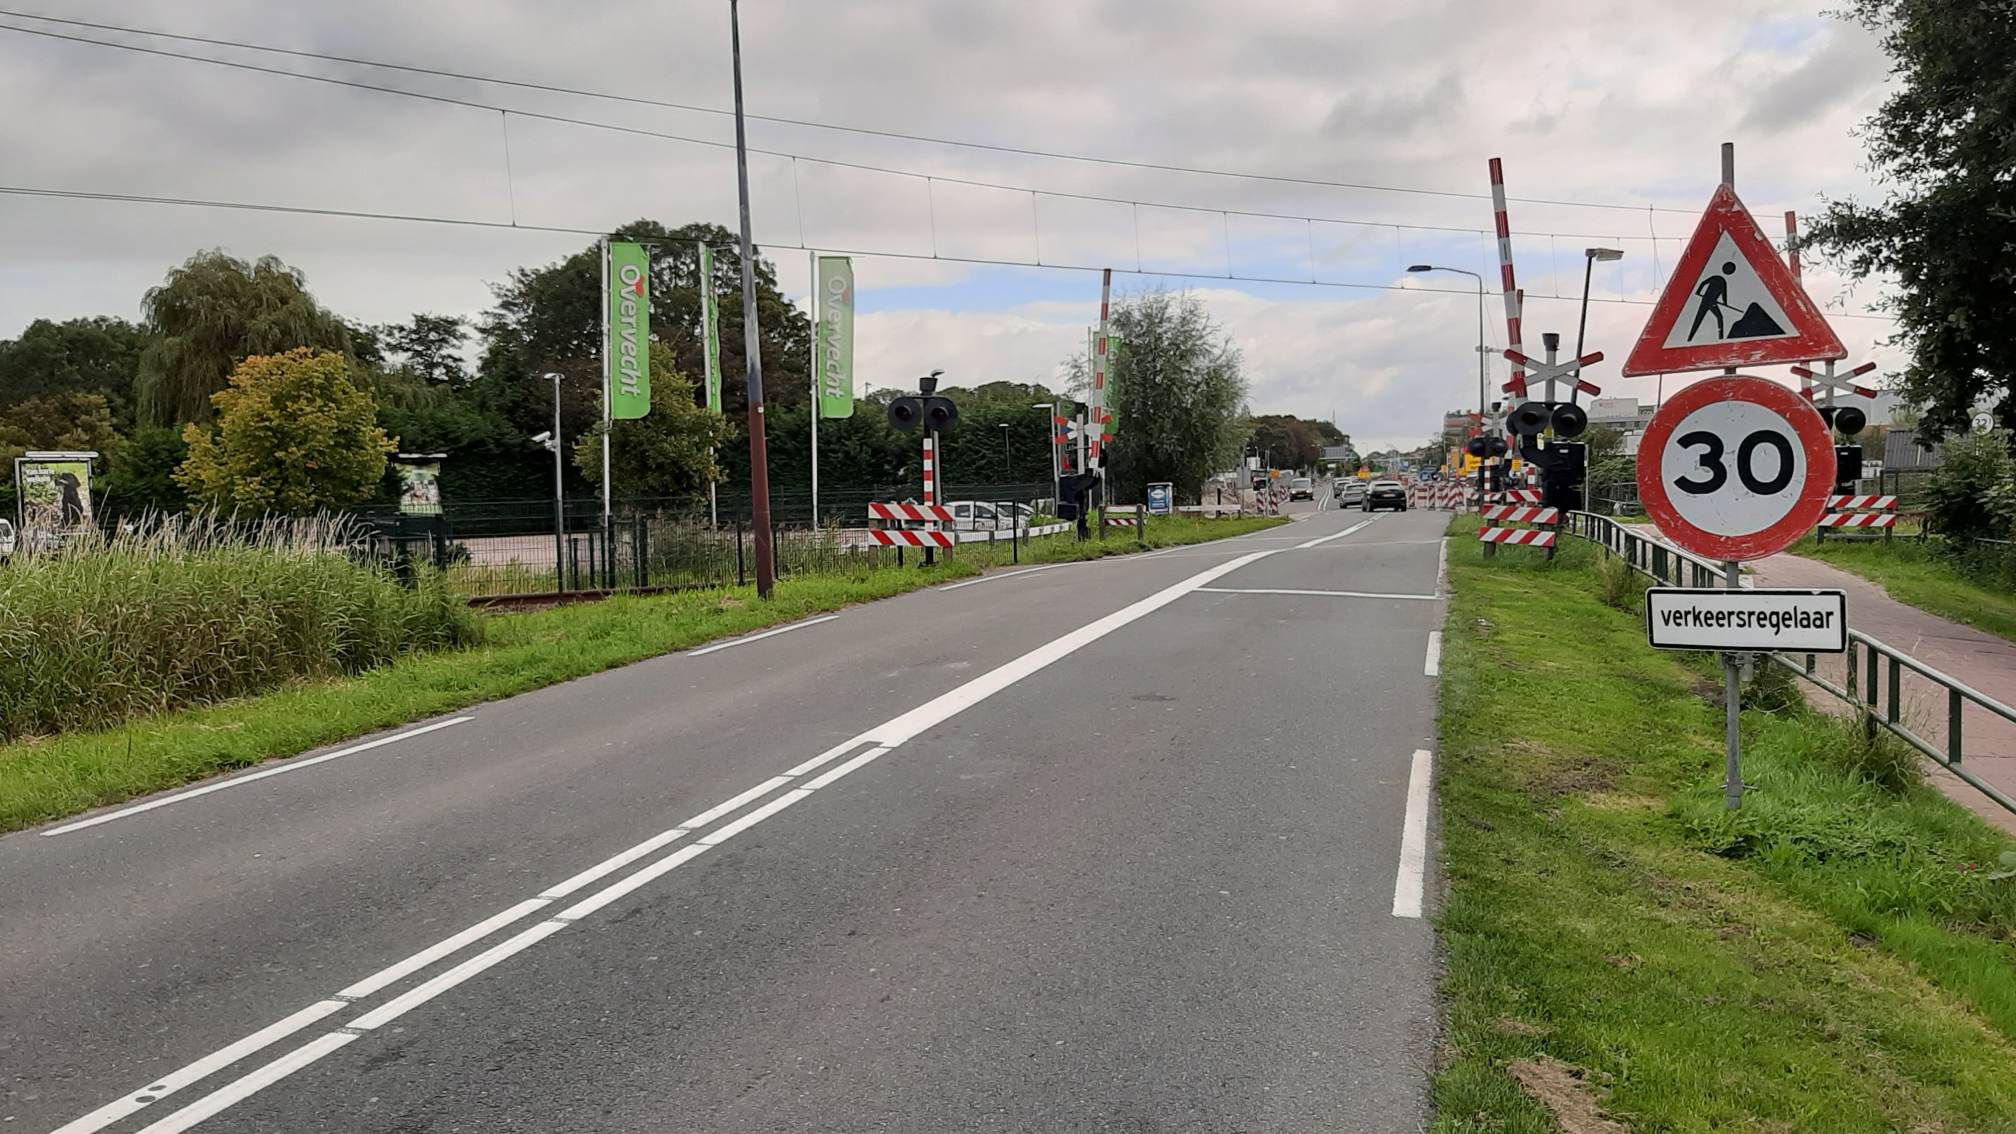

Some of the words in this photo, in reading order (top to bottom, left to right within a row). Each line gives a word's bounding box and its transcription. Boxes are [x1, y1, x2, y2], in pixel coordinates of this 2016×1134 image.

[620, 264, 641, 396] Overvecht
[825, 276, 846, 399] Overvecht
[1673, 430, 1795, 495] 30
[1660, 605, 1834, 636] verkeersregelaar
